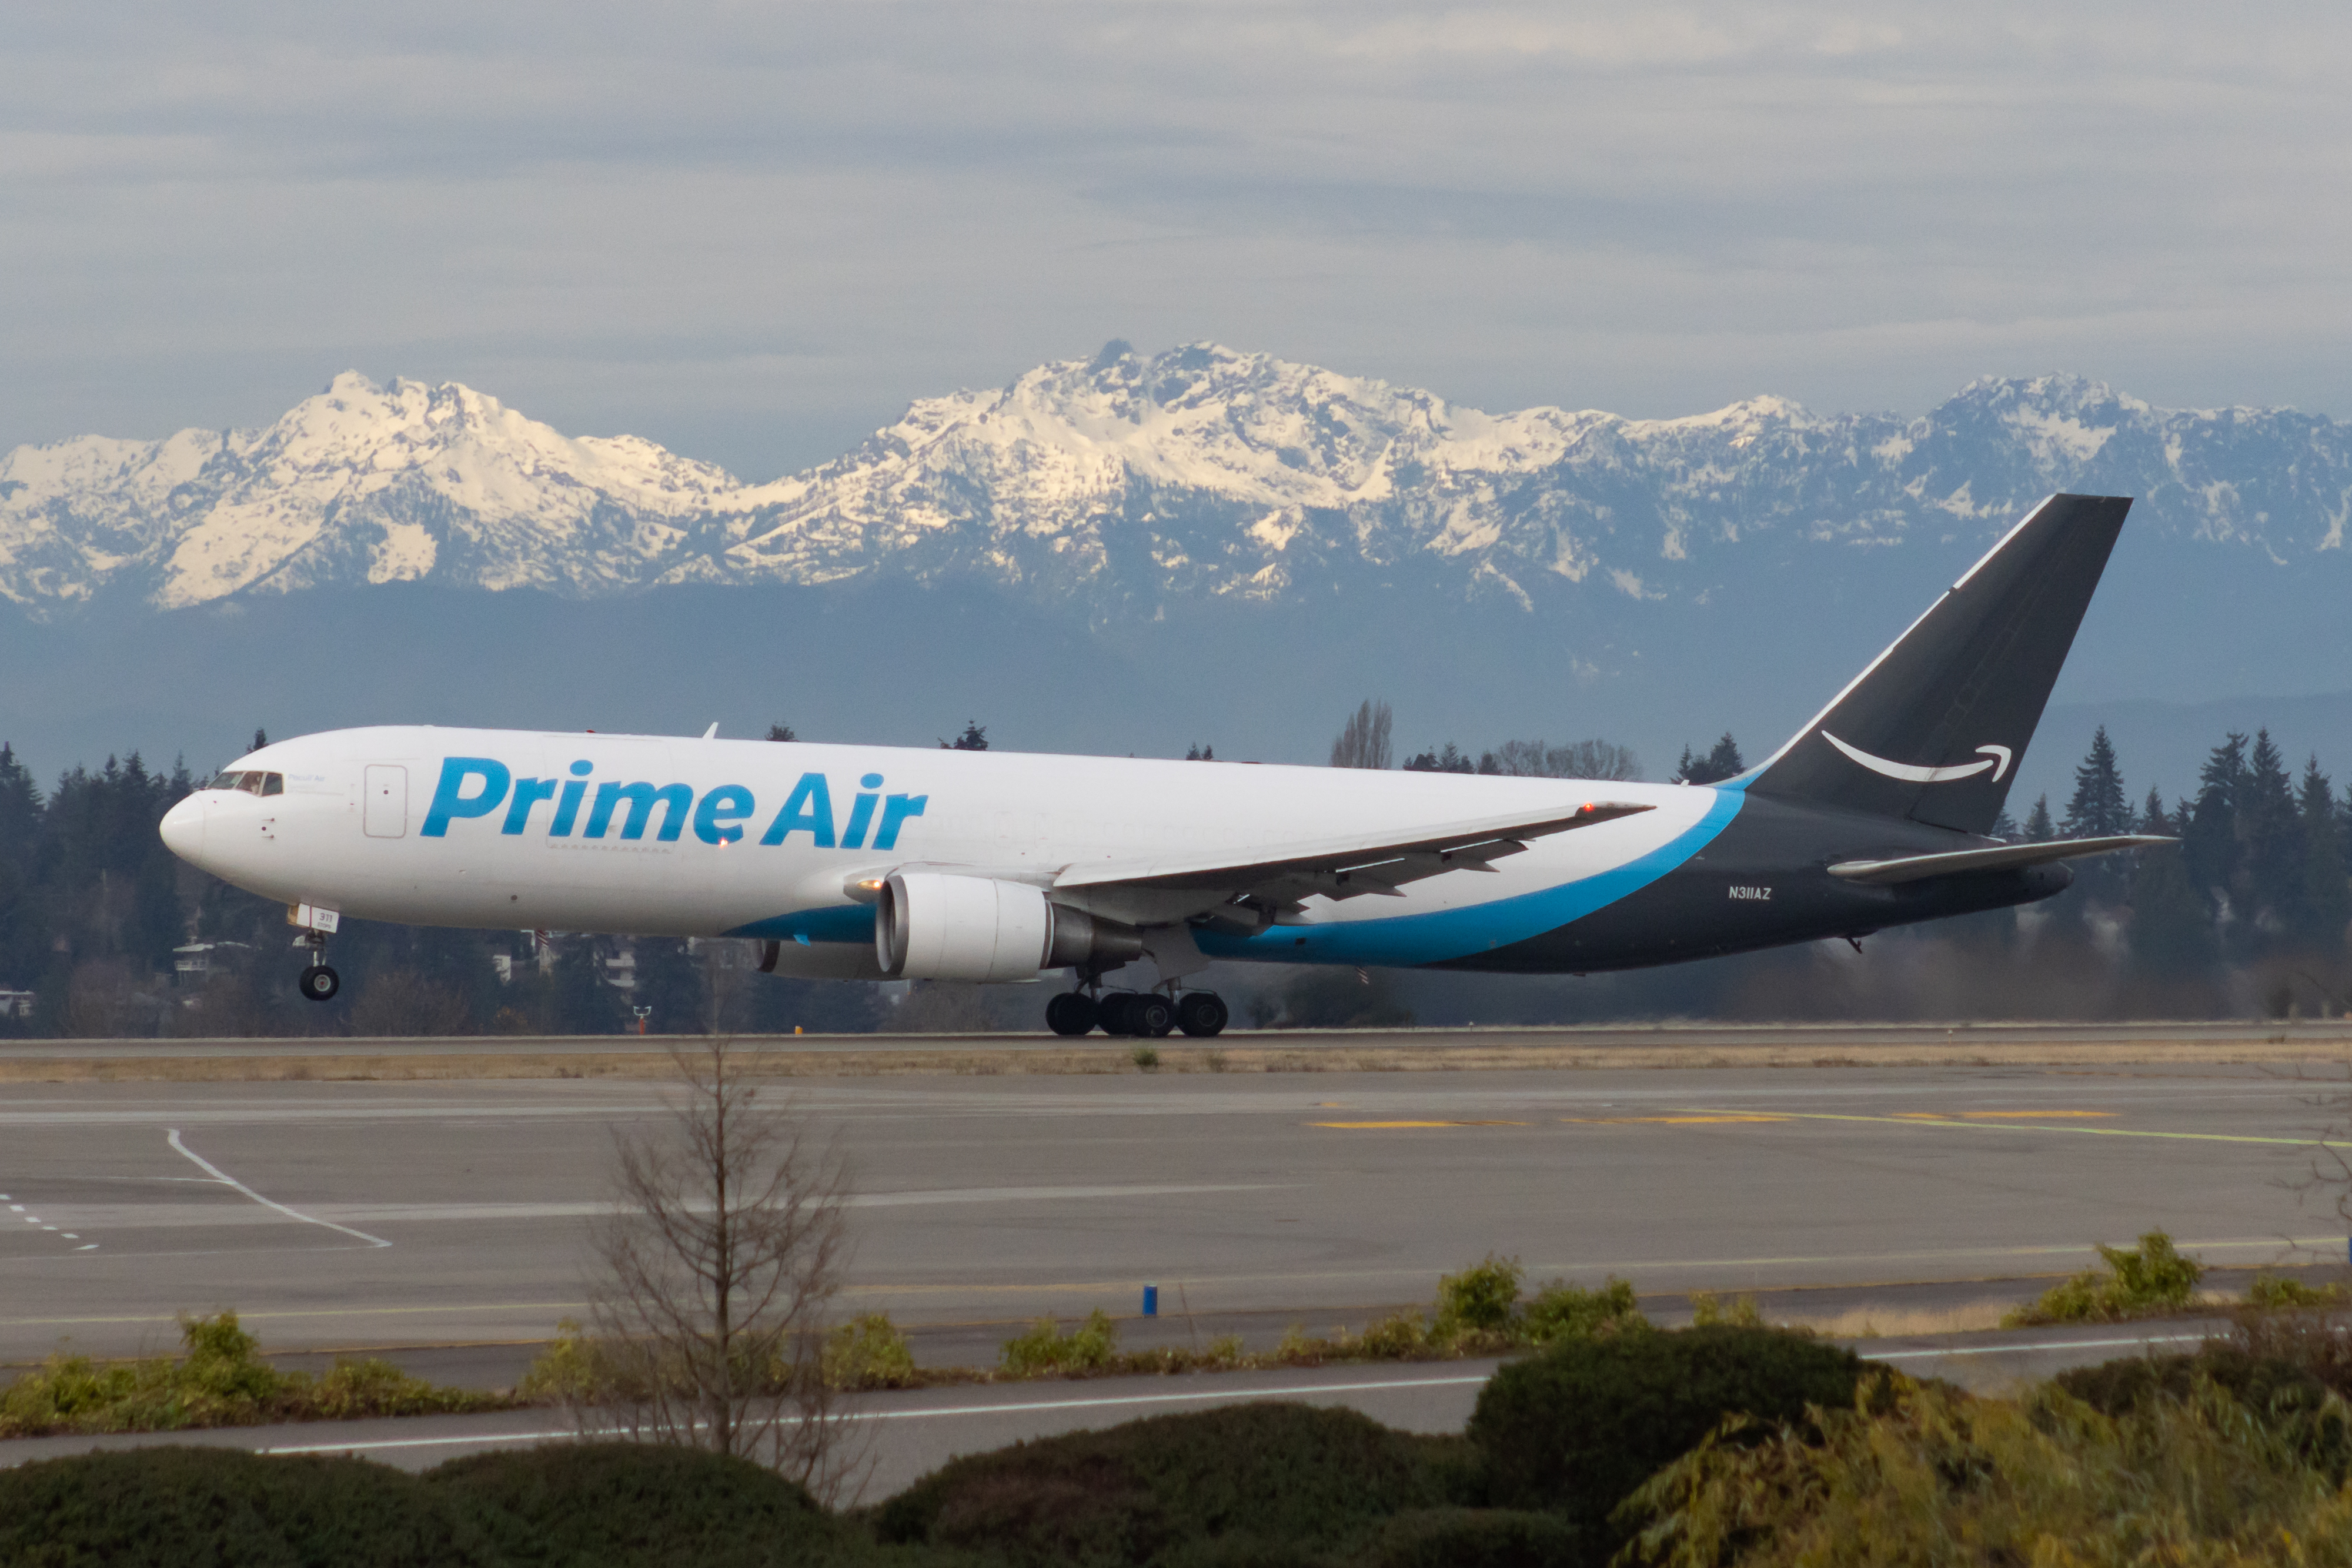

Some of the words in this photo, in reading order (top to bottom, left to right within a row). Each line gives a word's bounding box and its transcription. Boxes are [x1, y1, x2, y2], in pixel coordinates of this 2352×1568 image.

[420, 757, 755, 845] Prime
[760, 773, 928, 851] Air
[1729, 886, 1772, 900] N311AZ
[319, 912, 333, 922] 311
